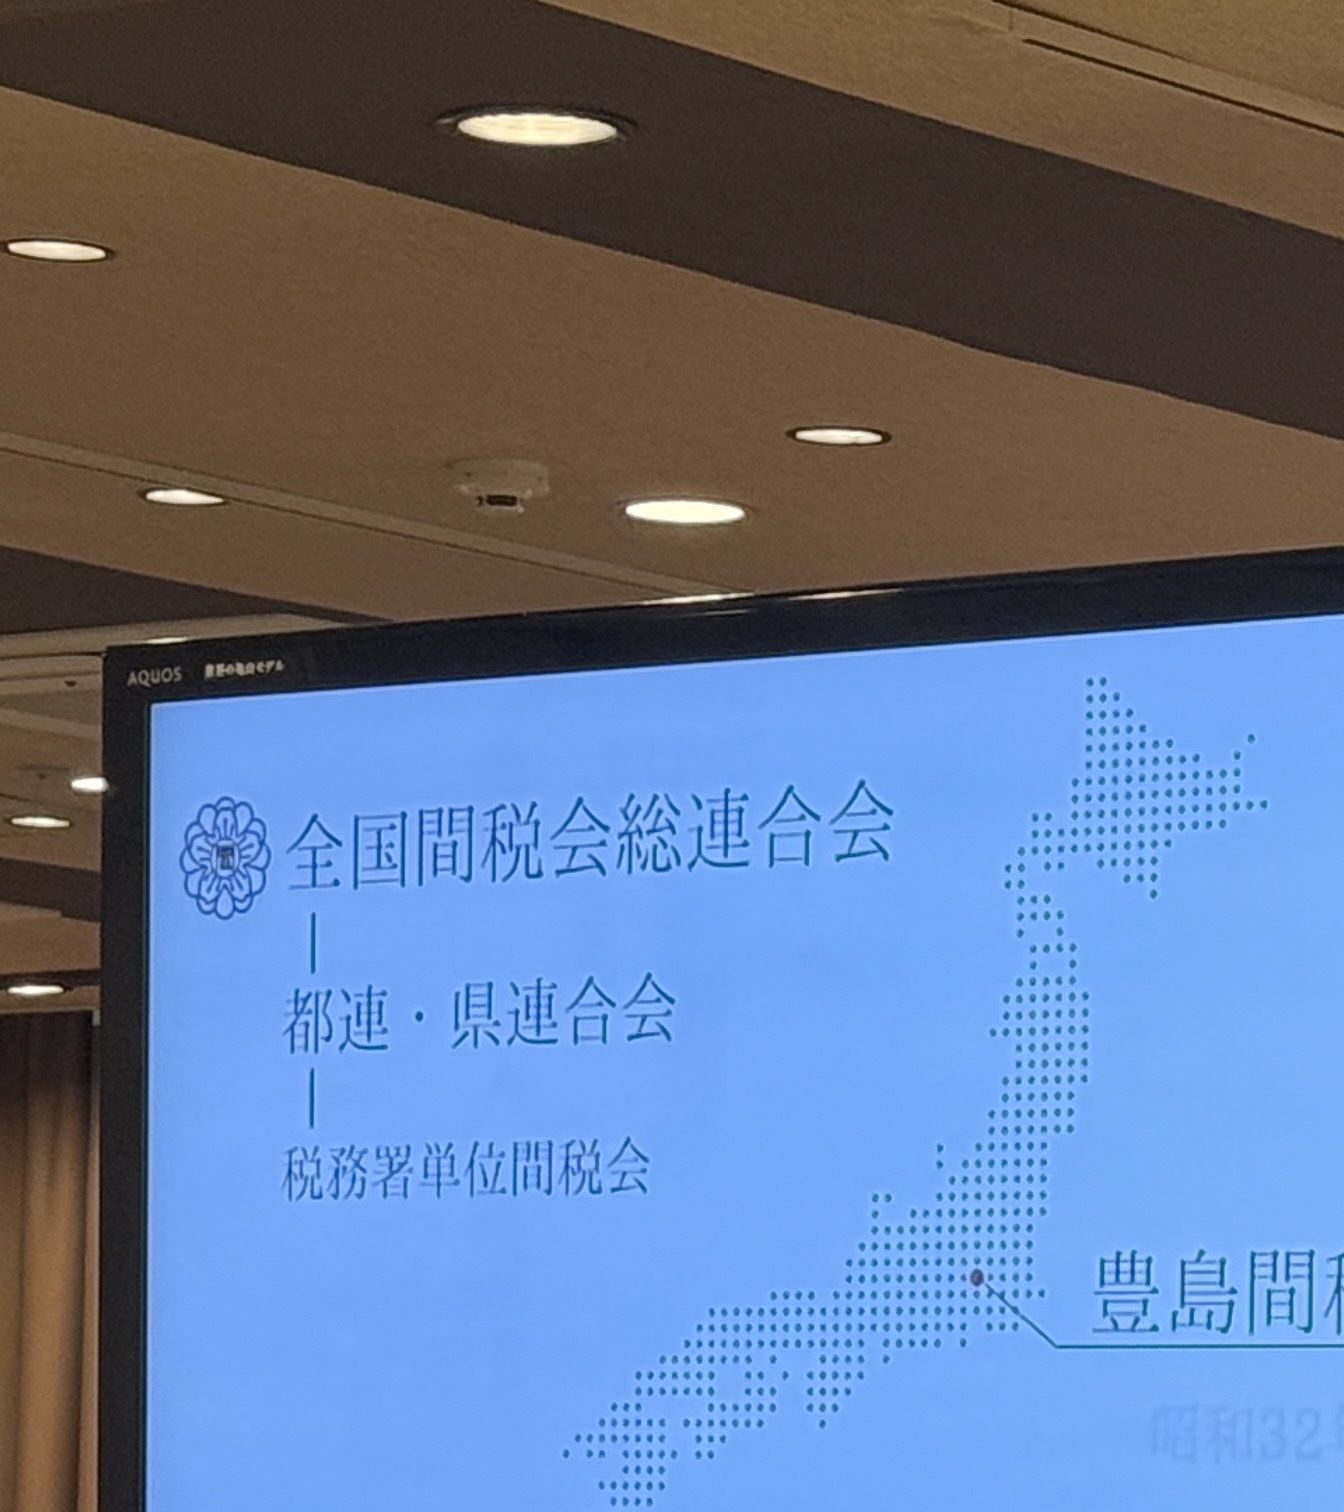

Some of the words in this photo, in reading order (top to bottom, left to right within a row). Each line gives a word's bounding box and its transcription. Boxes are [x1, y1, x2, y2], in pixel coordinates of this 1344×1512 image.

[127, 666, 183, 688] AQUOS
[285, 779, 895, 892] 全国間税会総連合会
[283, 971, 677, 1056] 都連・県連合会
[281, 1136, 651, 1203] 税務署単位間税会
